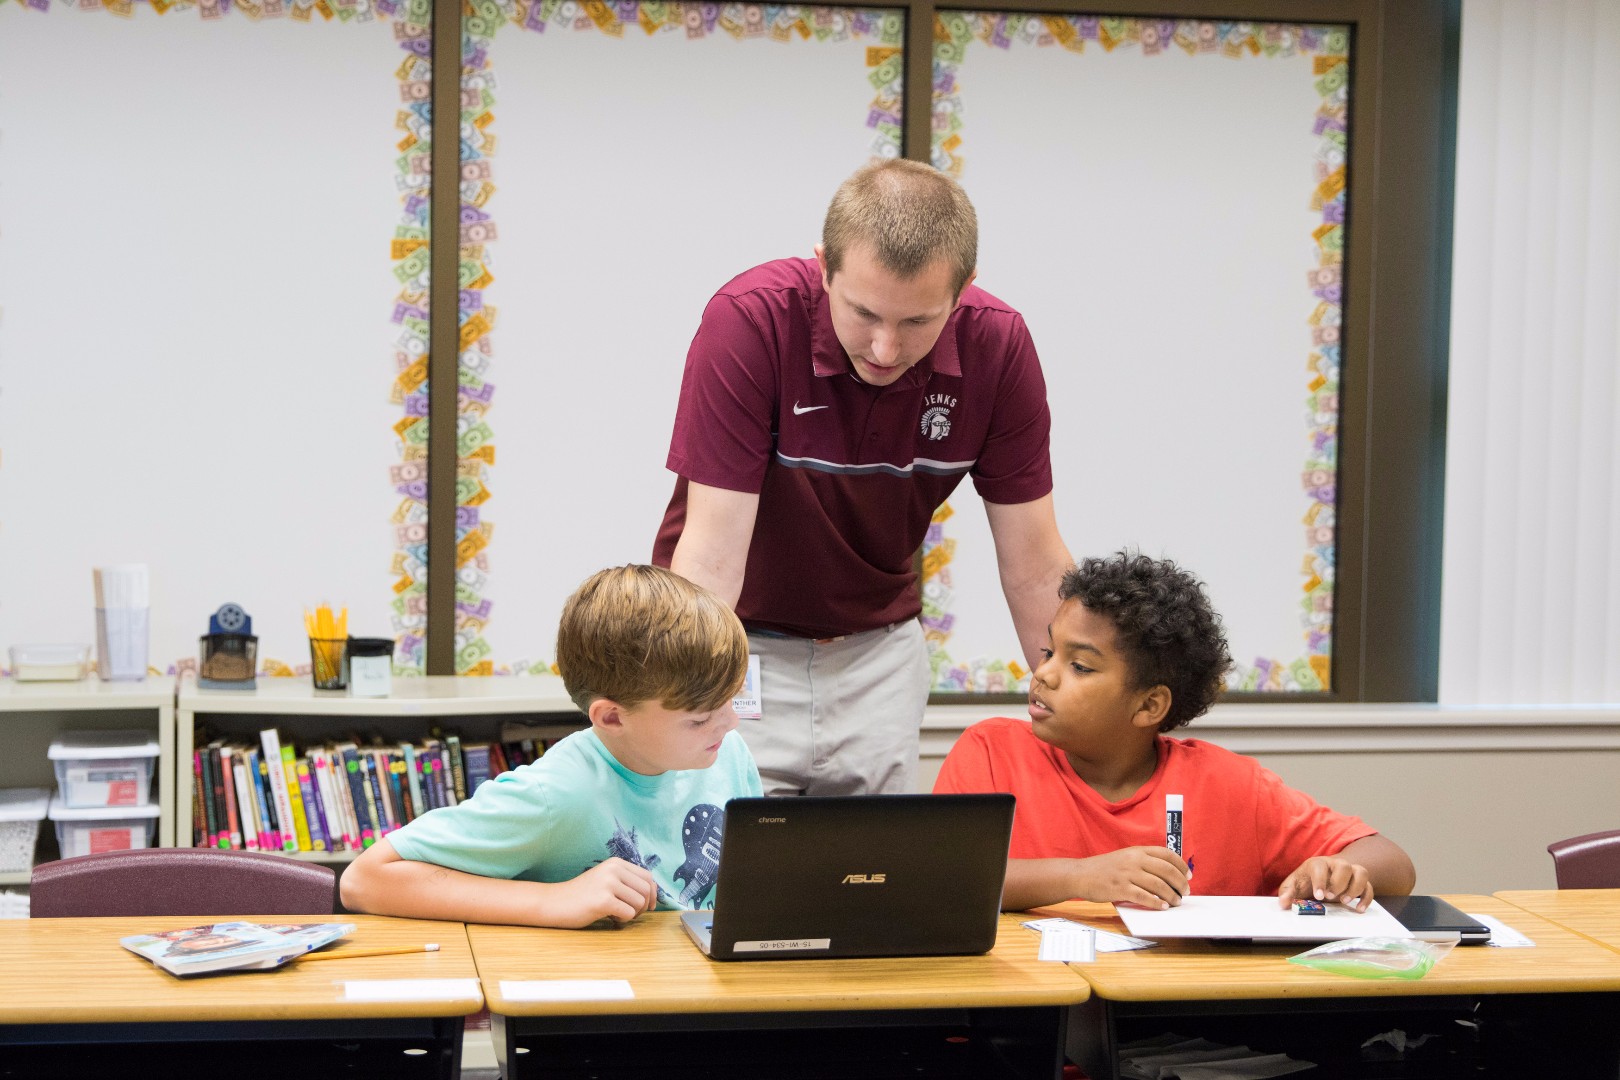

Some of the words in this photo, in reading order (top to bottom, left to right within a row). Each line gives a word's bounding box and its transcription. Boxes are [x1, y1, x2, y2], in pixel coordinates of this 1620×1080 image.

[924, 393, 957, 407] JENKS
[1168, 834, 1177, 851] PO
[841, 873, 886, 884] ASUS
